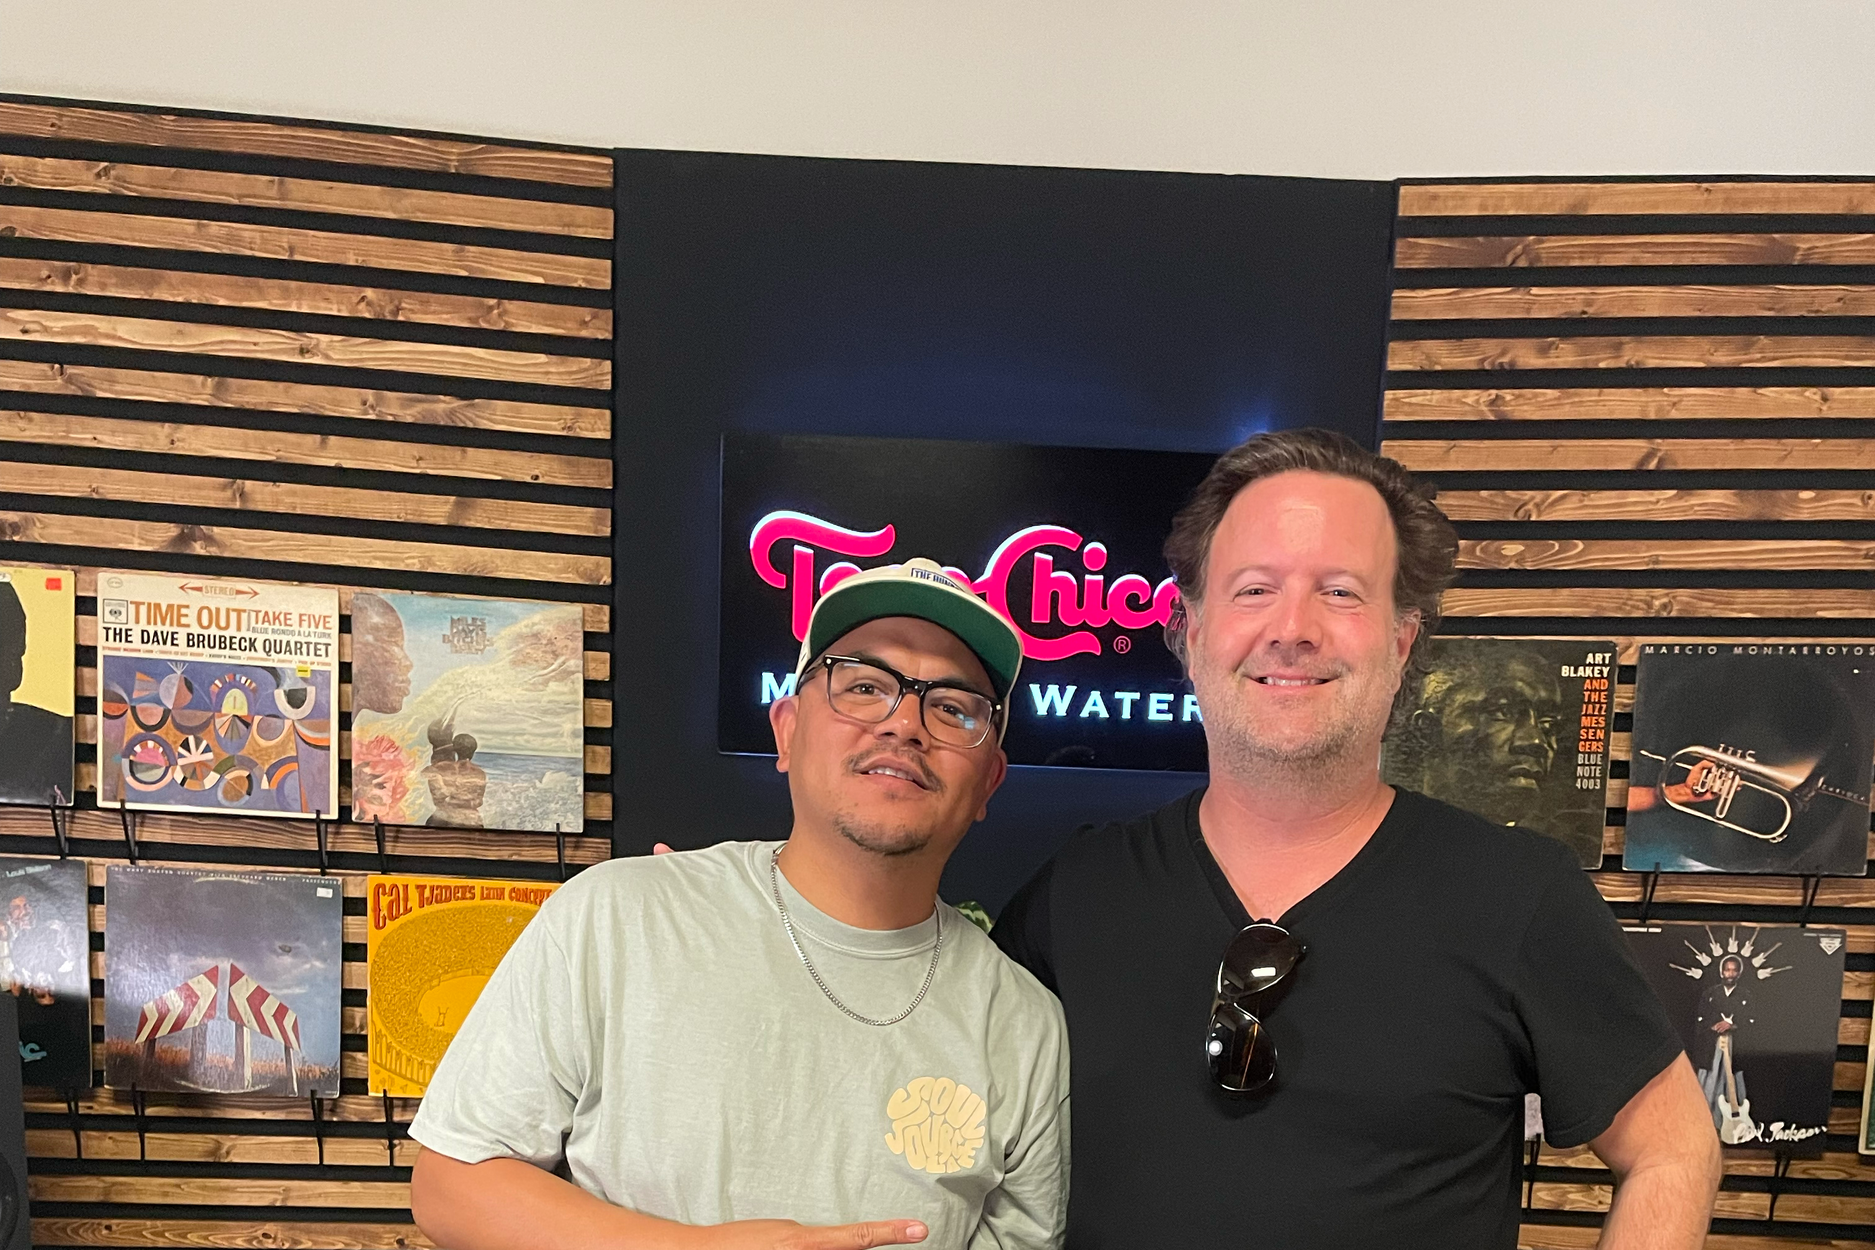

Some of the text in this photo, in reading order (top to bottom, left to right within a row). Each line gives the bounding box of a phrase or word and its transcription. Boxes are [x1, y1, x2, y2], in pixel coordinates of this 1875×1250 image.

[915, 570, 932, 580] THE
[204, 585, 235, 597] STEREO
[130, 601, 247, 632] TIME OUT
[253, 609, 332, 630] TAKE FIVE
[252, 626, 269, 635] BLUE
[271, 628, 296, 637] RONDO
[303, 630, 311, 638] LA
[313, 631, 331, 639] TURK
[102, 626, 133, 644] THE
[140, 629, 179, 647] DAVE
[186, 632, 257, 653] BRUBECK
[262, 638, 332, 658] QUARTET
[1644, 646, 1875, 656] MARCIO MONTARROYOS
[1586, 653, 1612, 664] ART
[1561, 666, 1610, 678] BLAKEY
[1583, 679, 1609, 690] AND
[1583, 691, 1608, 702] THE
[1028, 683, 1204, 722] WATER
[1581, 704, 1607, 715] JAZZ
[1580, 716, 1606, 728] MES
[1580, 729, 1605, 740] SEN
[1578, 741, 1604, 752] GERS
[1577, 753, 1602, 765] BLUE
[1576, 766, 1602, 777] NOTE
[1575, 779, 1600, 790] 4003
[886, 1076, 987, 1140] SOUL
